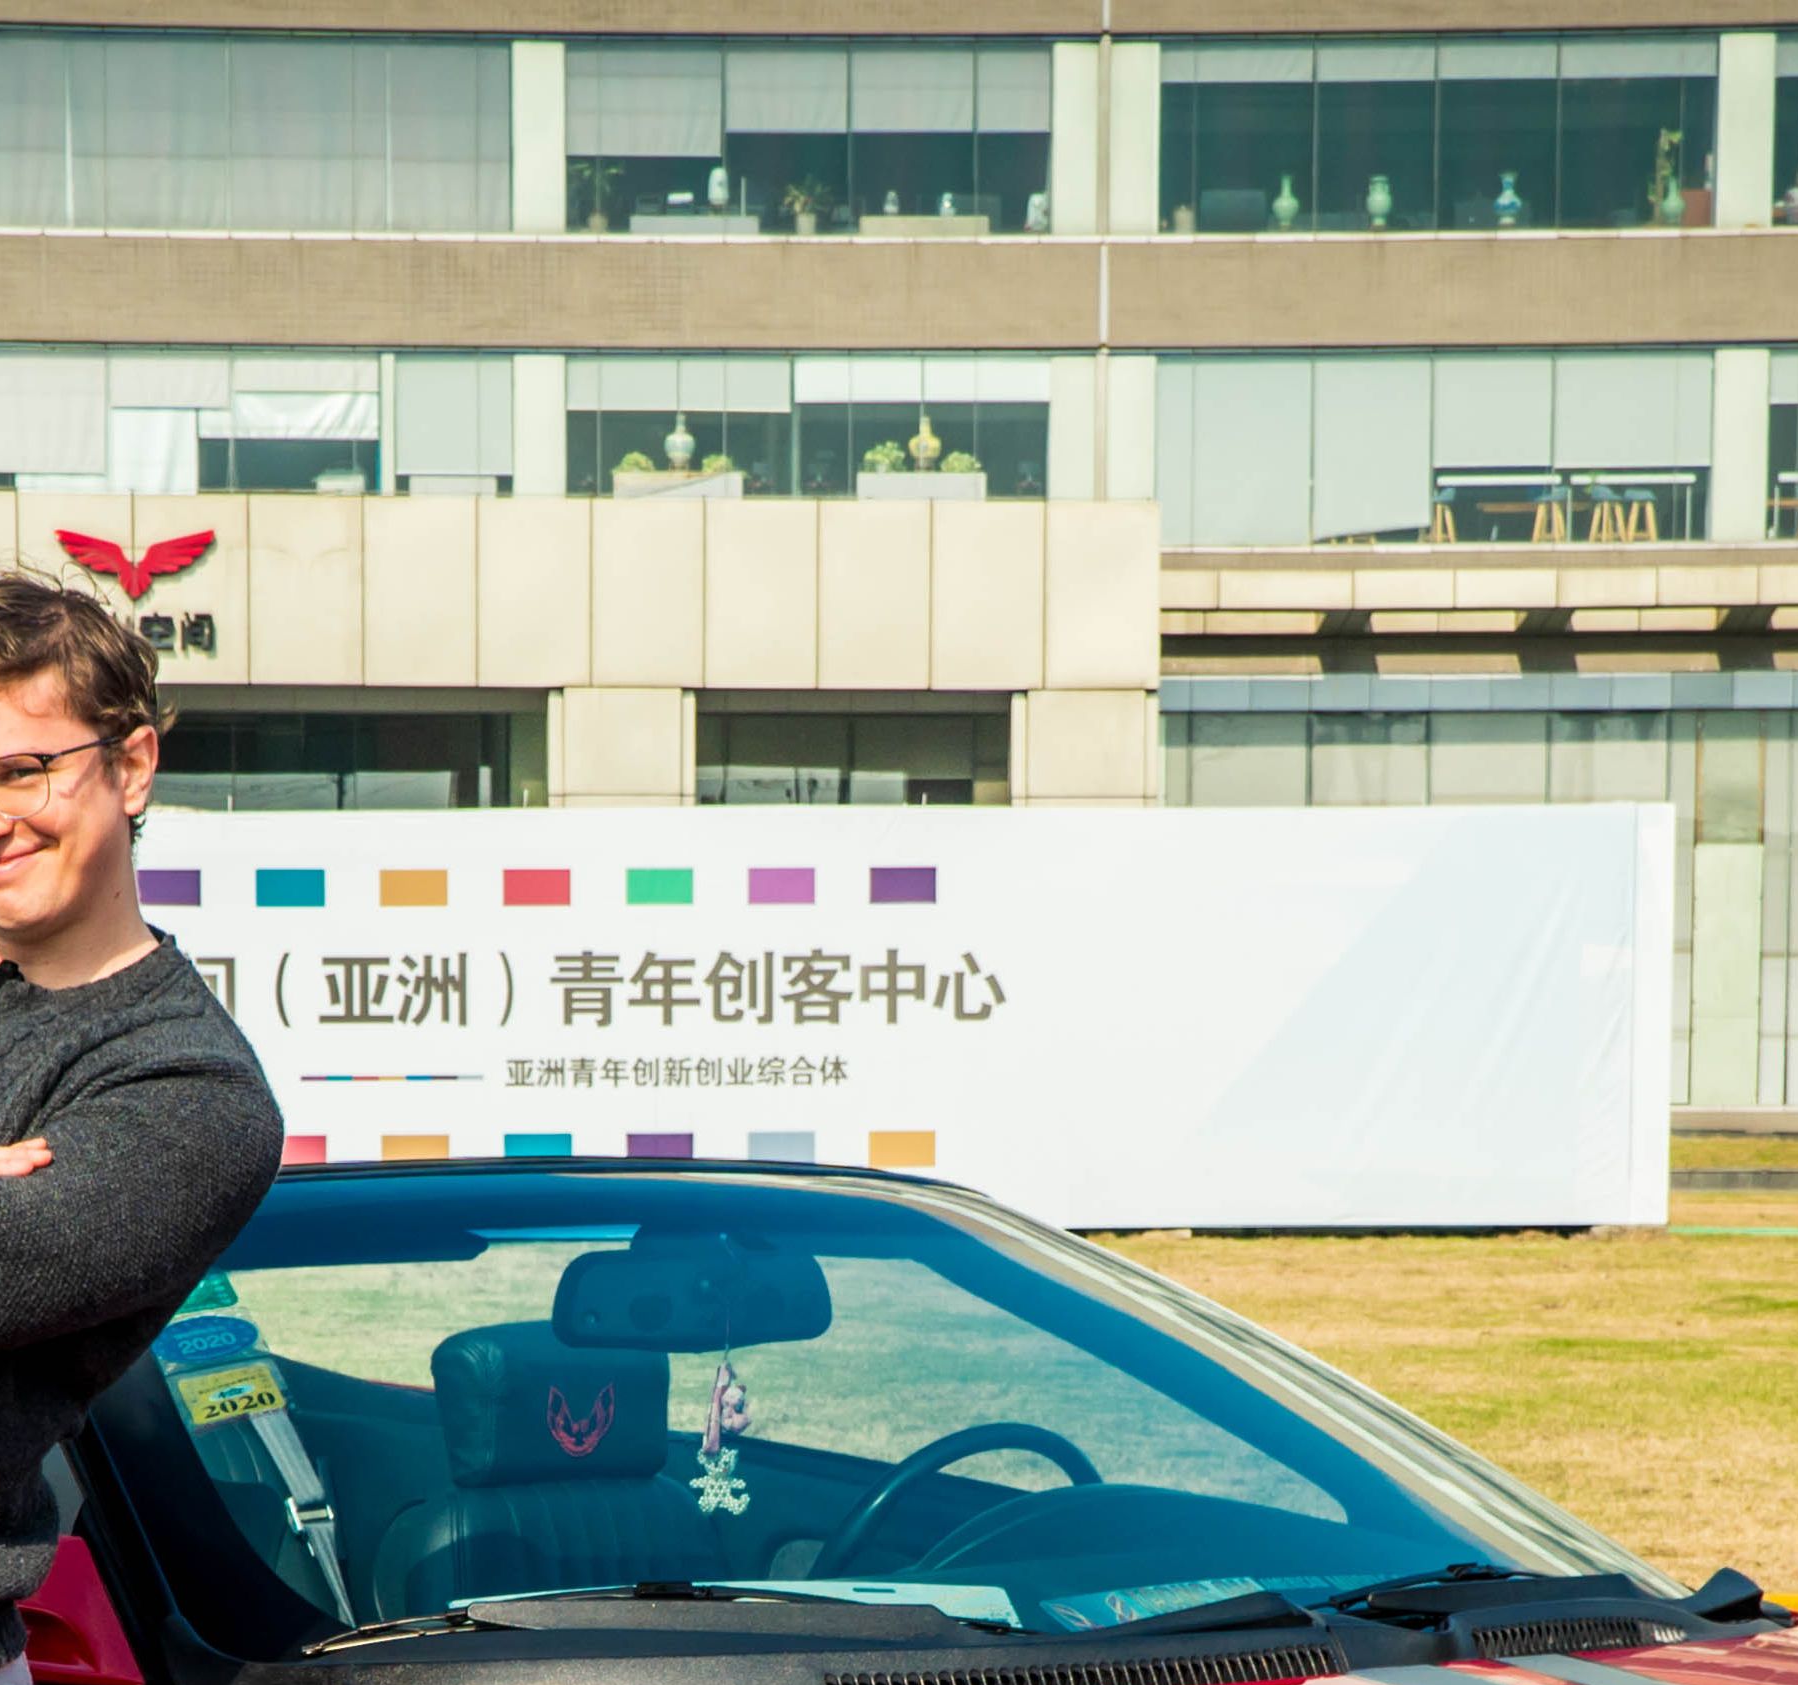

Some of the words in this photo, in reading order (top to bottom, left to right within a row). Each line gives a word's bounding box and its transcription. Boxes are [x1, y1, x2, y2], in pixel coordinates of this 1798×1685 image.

[112, 611, 216, 652] 空间
[505, 1055, 849, 1088] 亚洲青年创新创业综合体
[177, 1331, 237, 1355] 2020
[203, 1391, 276, 1419] 2020
